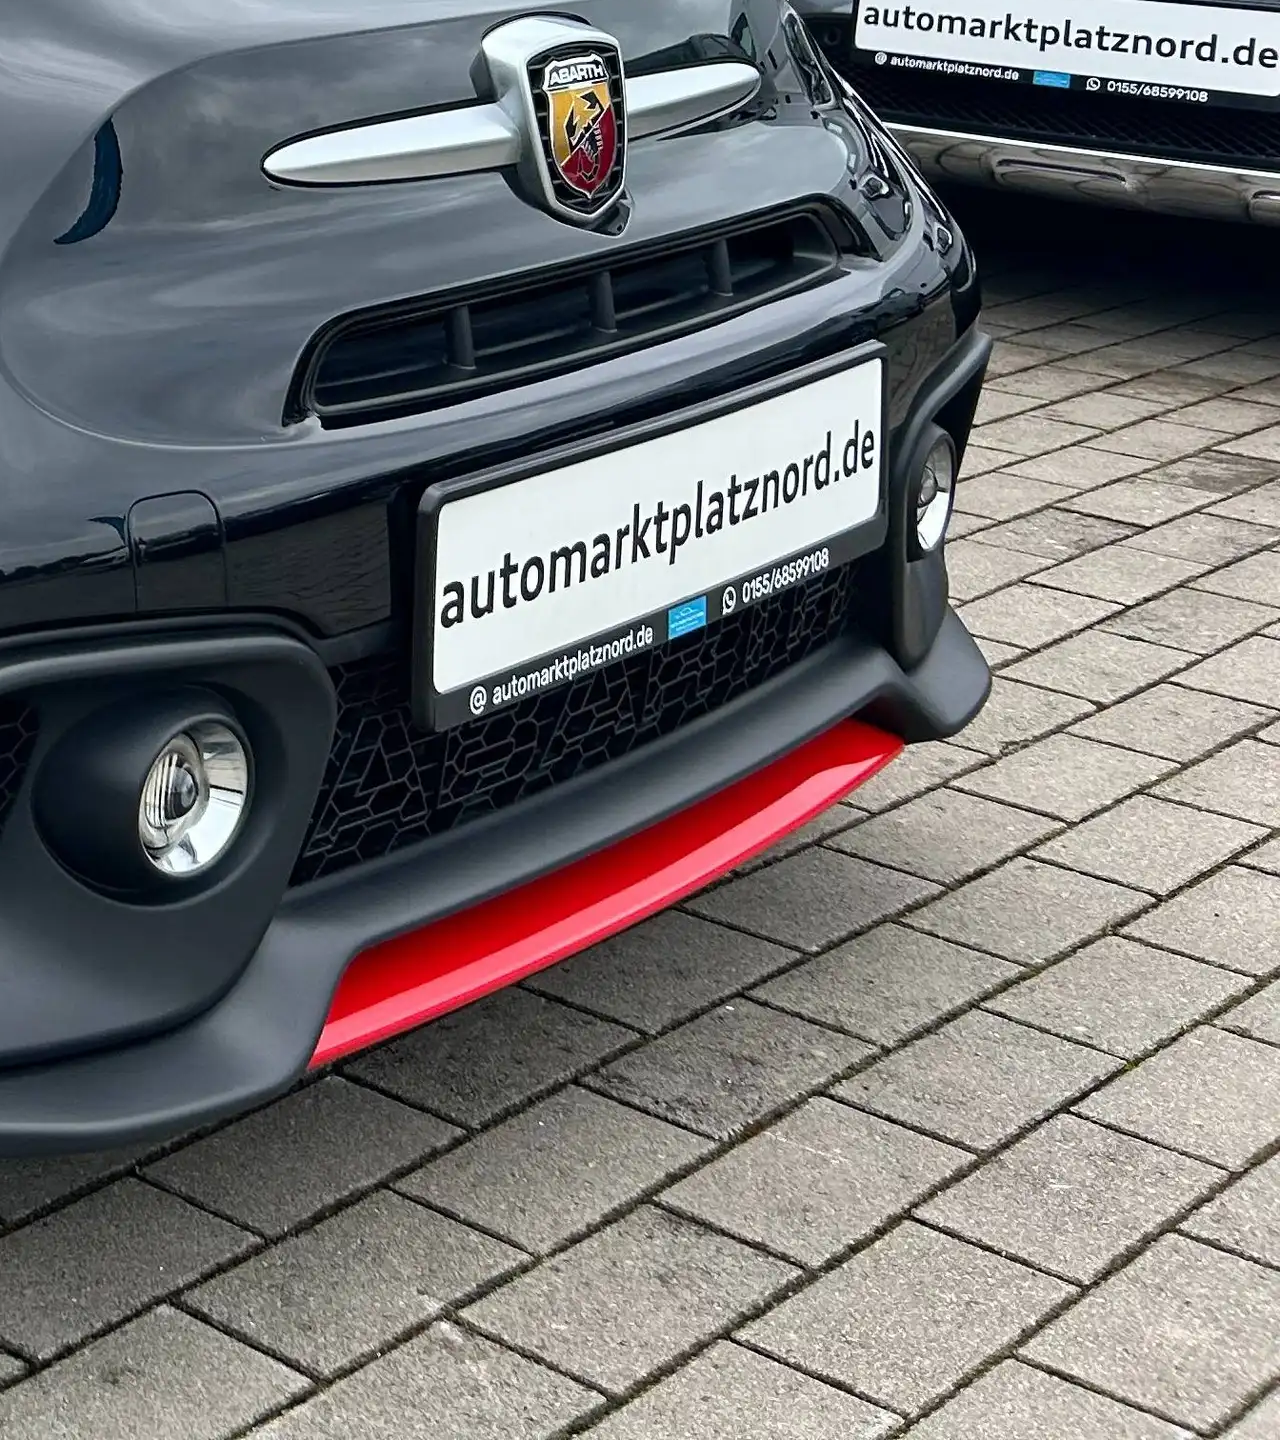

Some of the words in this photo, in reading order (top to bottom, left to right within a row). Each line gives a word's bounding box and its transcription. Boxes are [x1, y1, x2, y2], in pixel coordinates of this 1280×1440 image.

[864, 6, 1279, 68] automarktplatznord.de
[550, 63, 605, 85] ABARTH
[890, 55, 1019, 81] automarktplatznord.de
[1107, 80, 1208, 102] 0155/68599108
[441, 420, 875, 628] automarktplatznord.de
[742, 548, 829, 604] 0155/68599108
[492, 624, 653, 705] automarktplatznord.de
